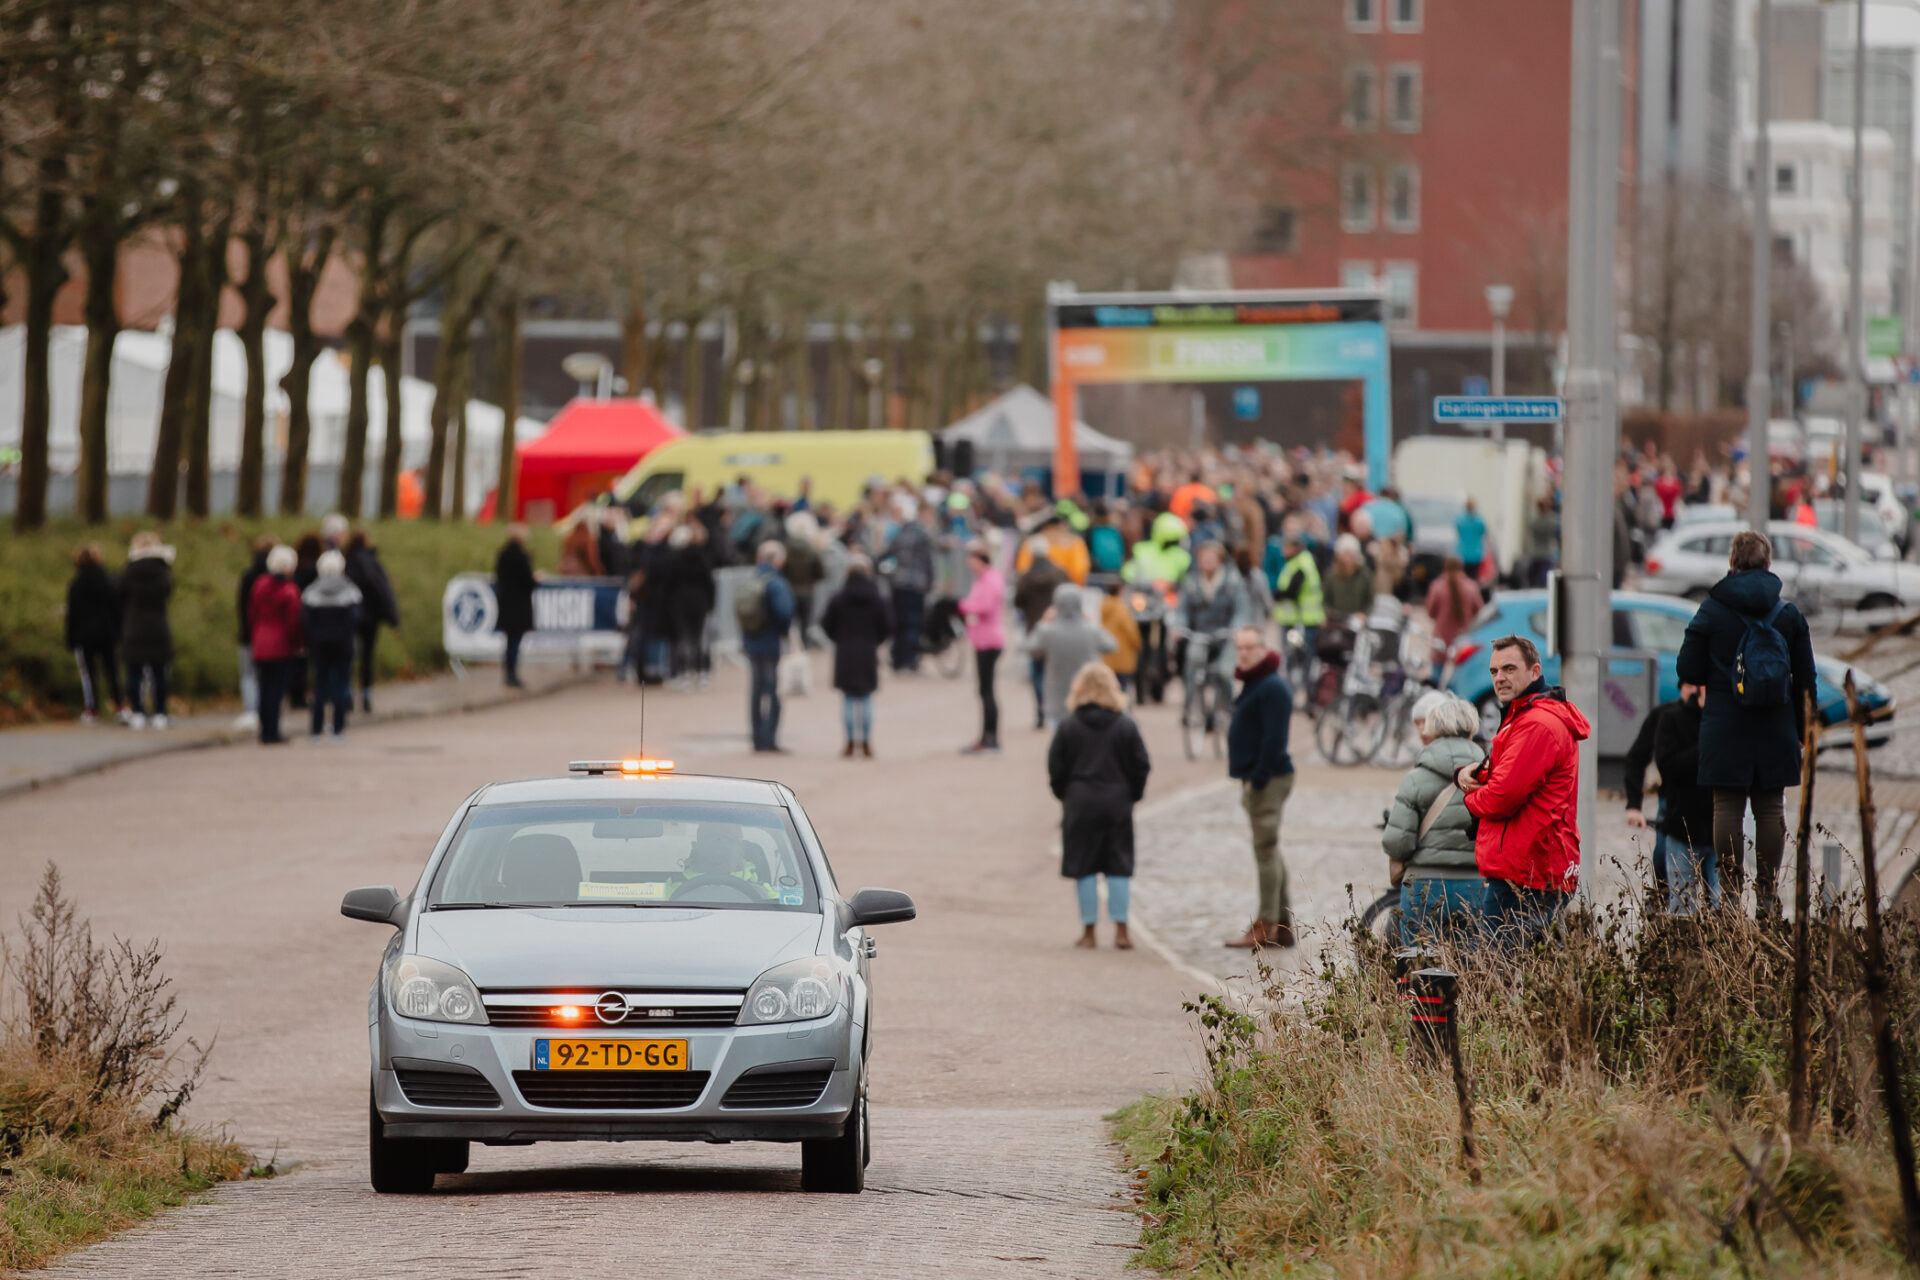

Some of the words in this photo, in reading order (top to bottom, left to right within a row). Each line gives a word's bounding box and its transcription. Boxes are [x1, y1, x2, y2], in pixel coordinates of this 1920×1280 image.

[1174, 338, 1266, 367] FINISH
[537, 1057, 548, 1065] NL
[557, 1043, 678, 1066] 92-TD-GG
